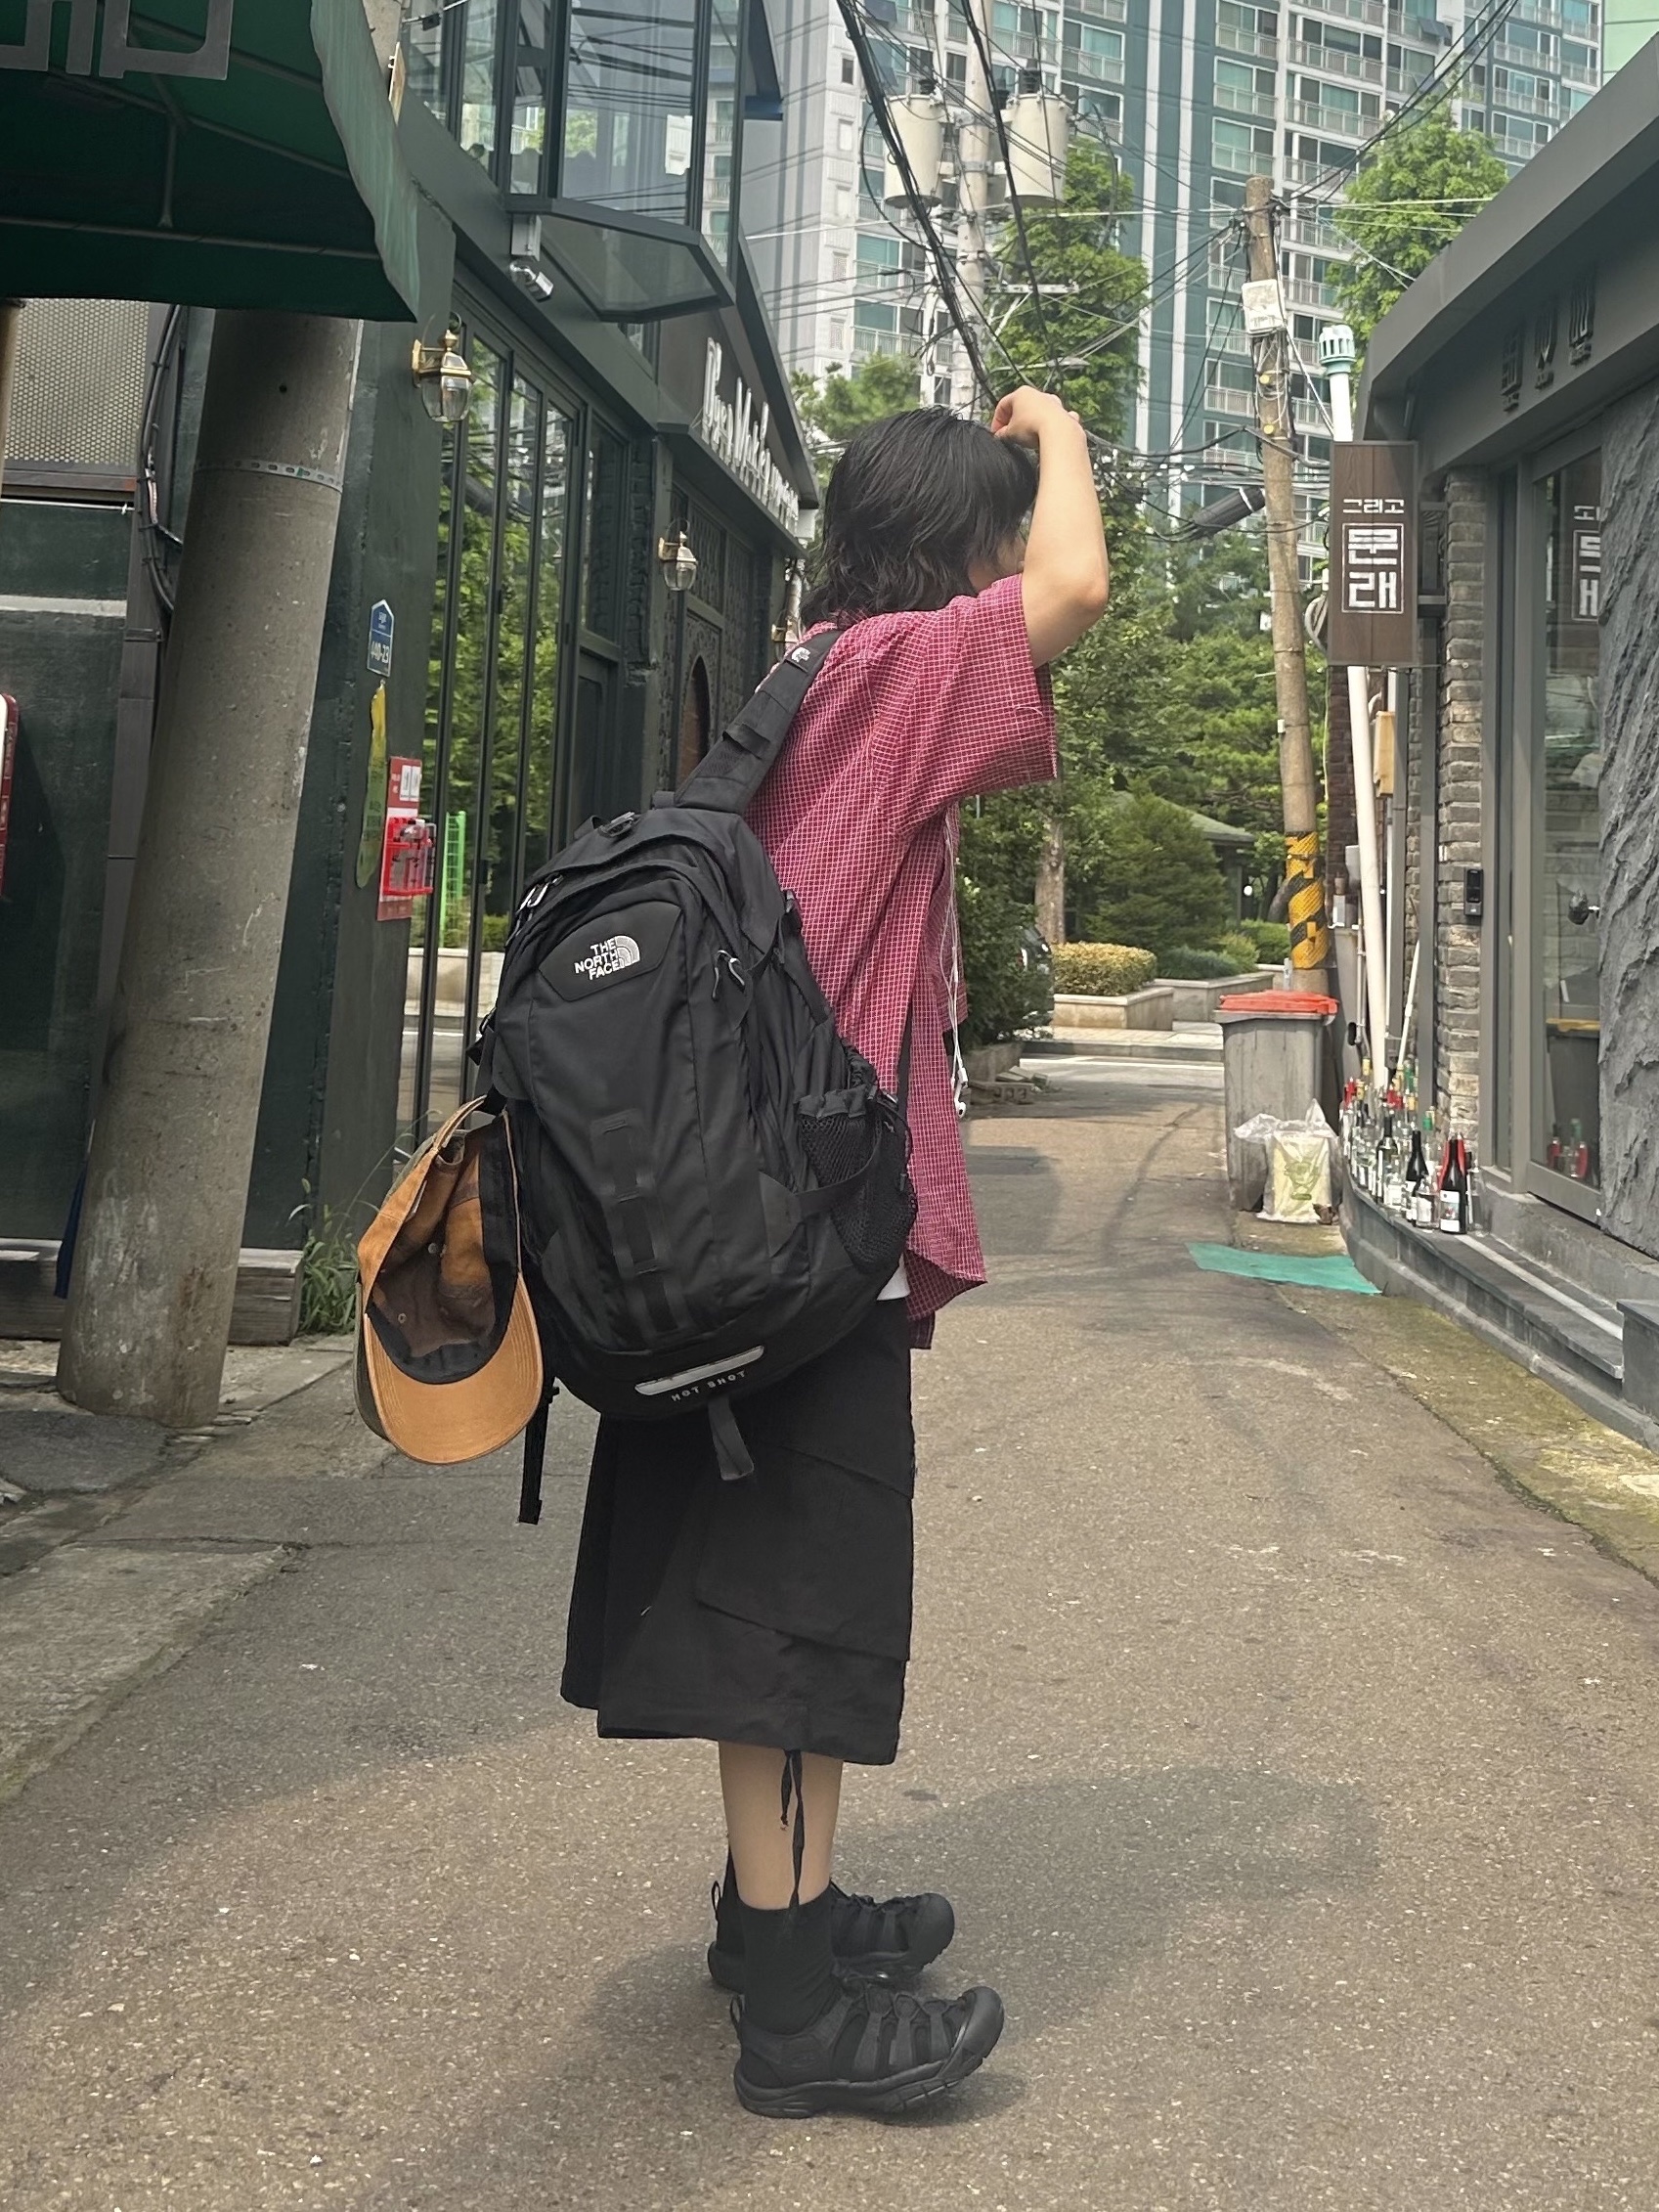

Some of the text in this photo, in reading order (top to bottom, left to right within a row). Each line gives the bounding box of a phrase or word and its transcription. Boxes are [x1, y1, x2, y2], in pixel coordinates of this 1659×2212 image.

[1342, 498, 1405, 514] 그리고
[1347, 528, 1399, 609] 문래
[589, 938, 617, 955] THE
[574, 949, 618, 974] NORTH
[589, 960, 619, 981] FACE
[671, 1370, 746, 1401] HOT SHOT
